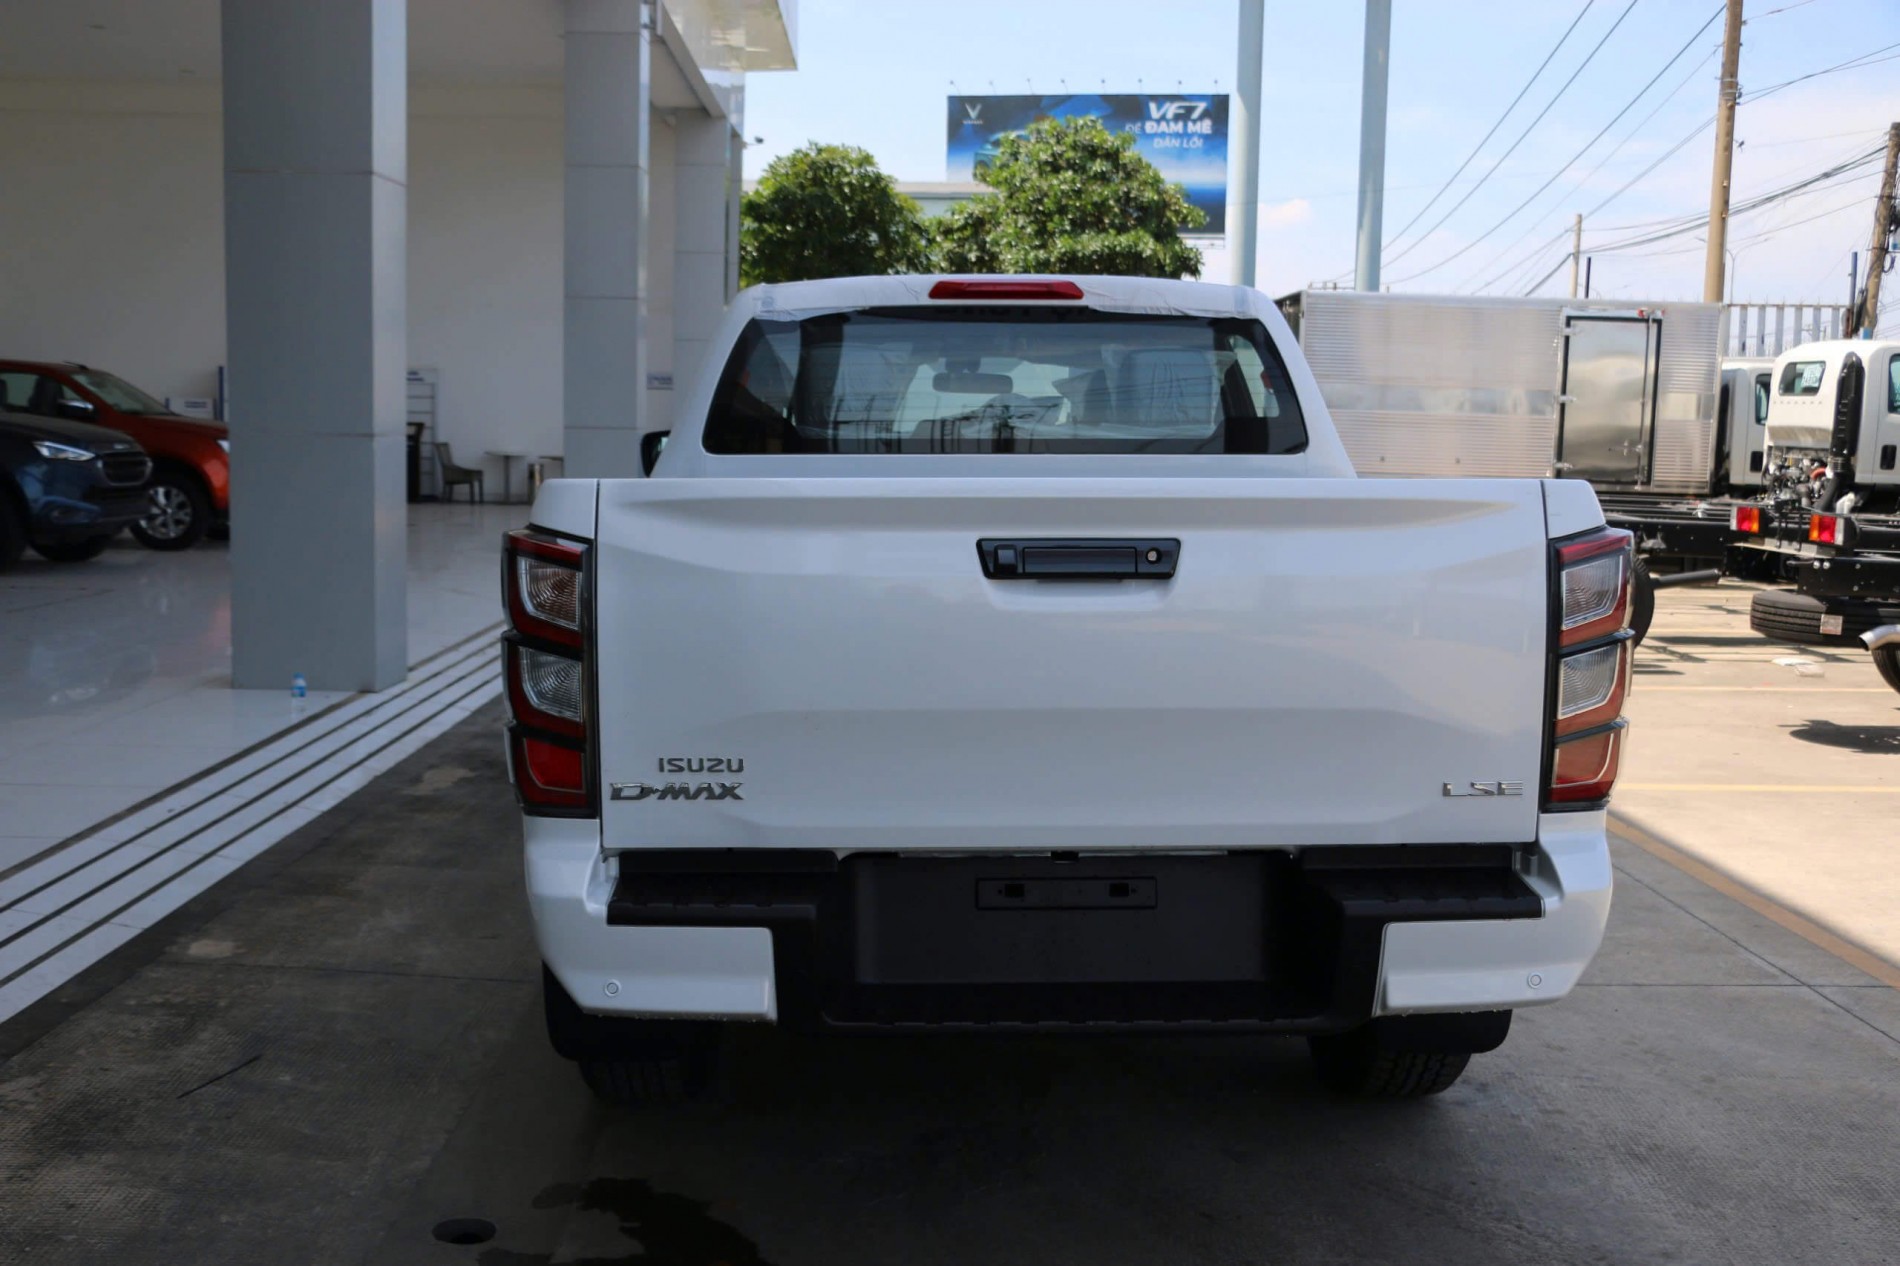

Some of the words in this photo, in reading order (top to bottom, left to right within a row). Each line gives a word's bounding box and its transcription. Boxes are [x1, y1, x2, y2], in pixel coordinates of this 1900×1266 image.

[1148, 101, 1207, 120] VF7
[658, 757, 744, 773] ISUZU
[610, 782, 744, 801] D-MAX
[1442, 781, 1523, 797] LSE
